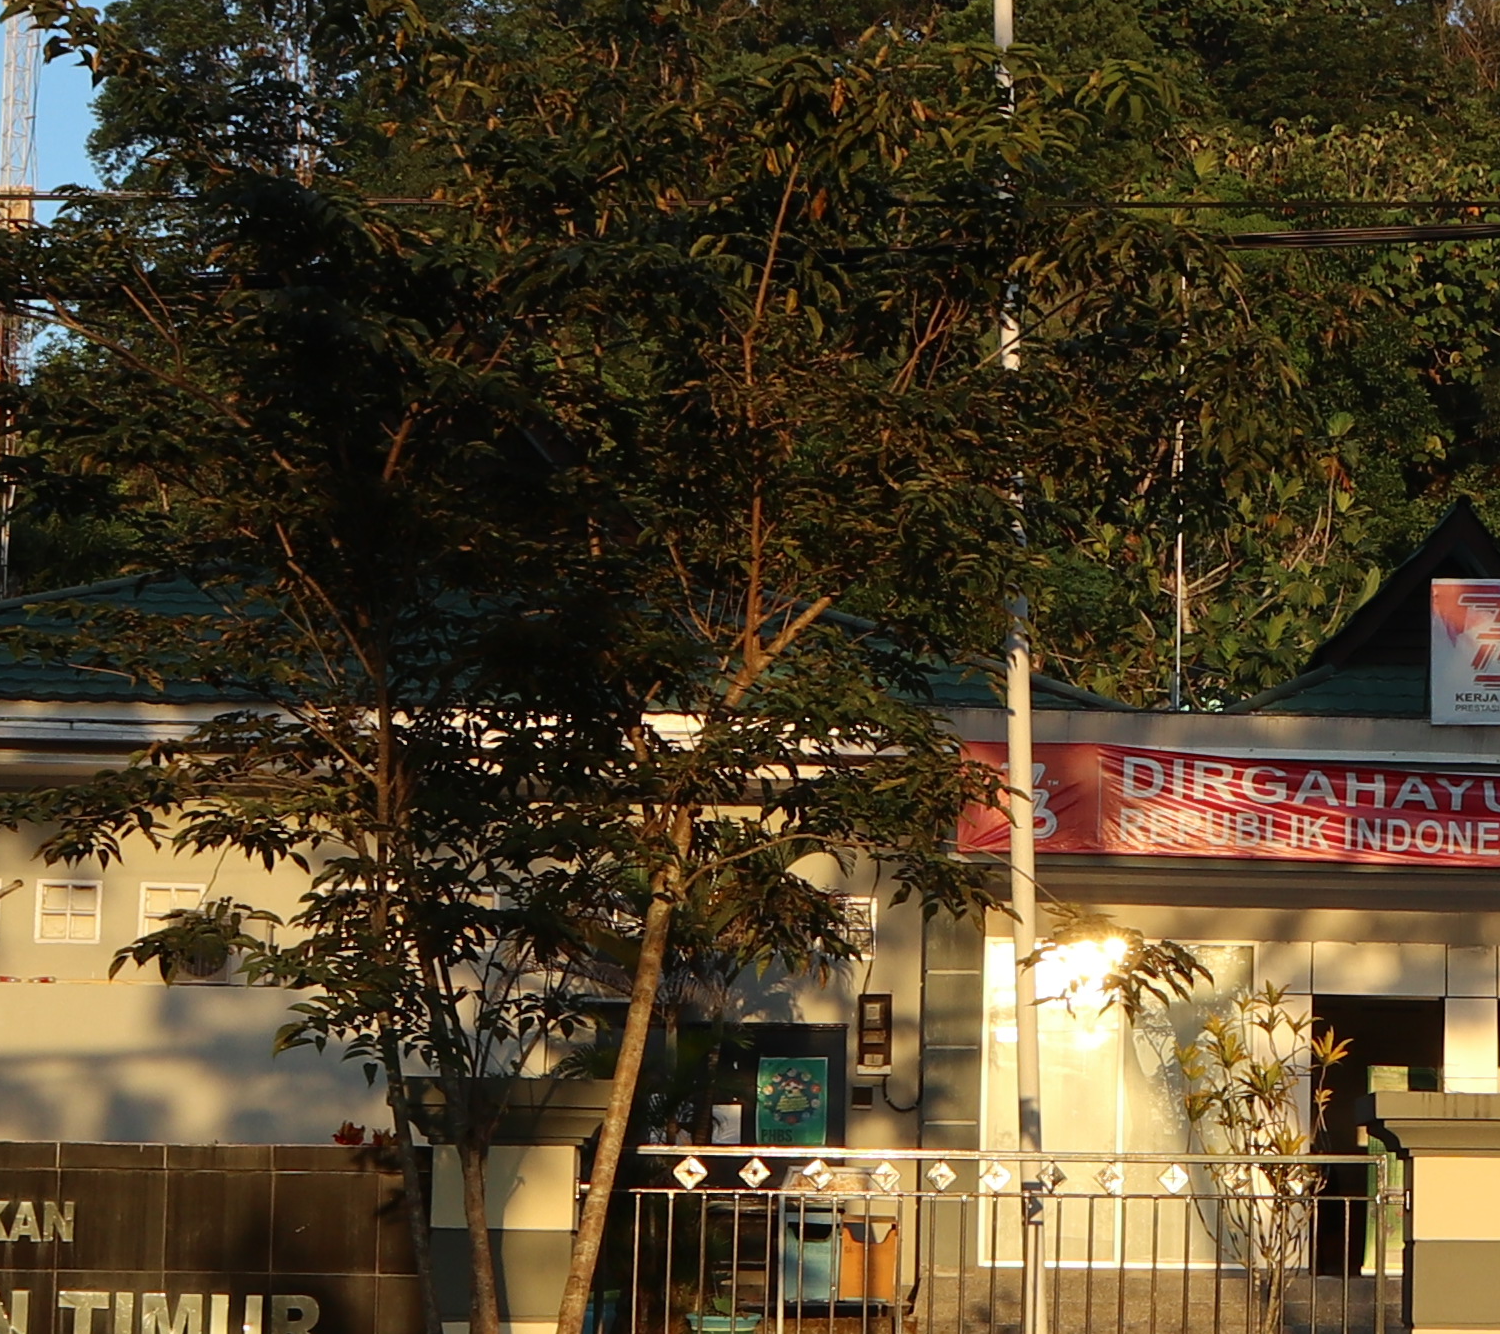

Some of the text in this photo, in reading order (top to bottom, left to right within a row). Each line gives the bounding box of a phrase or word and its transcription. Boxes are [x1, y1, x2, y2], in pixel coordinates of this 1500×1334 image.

[1455, 693, 1499, 703] KERJA
[1455, 704, 1500, 713] PRESTASI
[1119, 807, 1330, 850] REPUBLIK
[761, 1129, 792, 1142] PHBS
